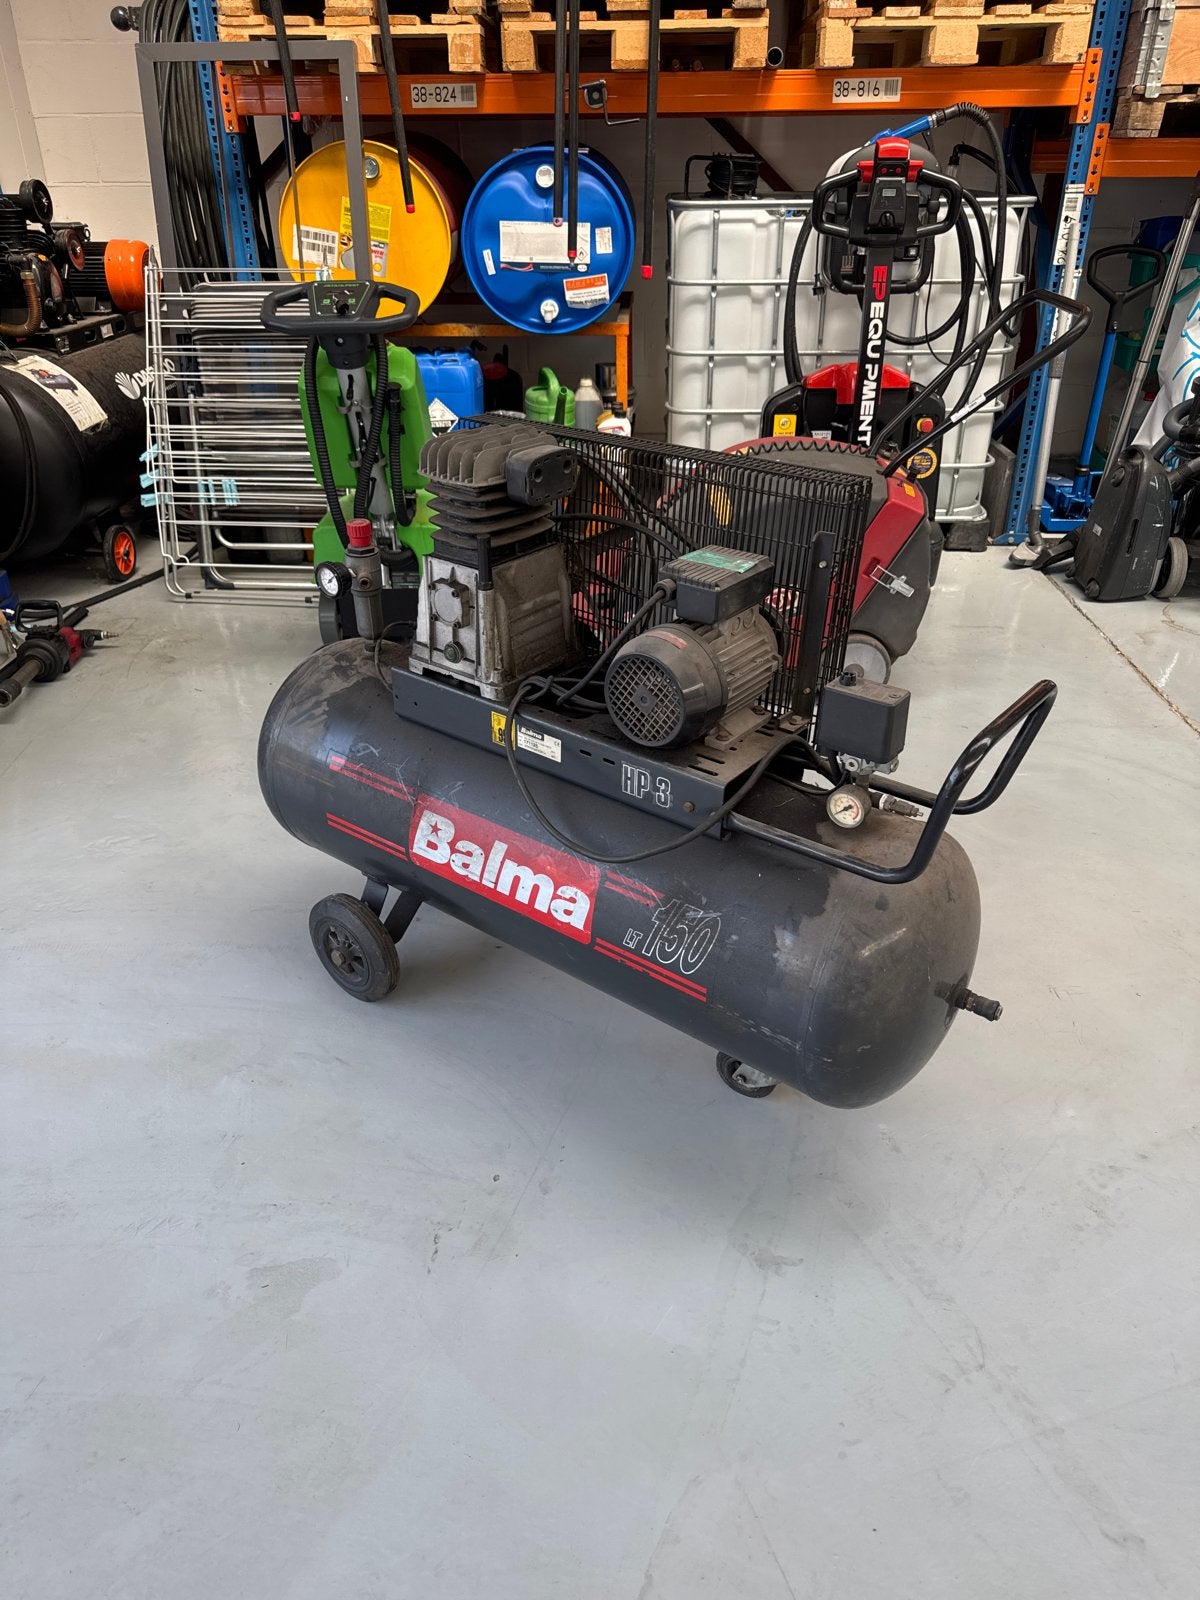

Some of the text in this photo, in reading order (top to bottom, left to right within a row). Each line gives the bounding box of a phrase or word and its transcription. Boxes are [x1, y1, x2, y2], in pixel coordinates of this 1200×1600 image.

[412, 86, 457, 103] 38-824
[834, 80, 880, 98] 38-816
[857, 265, 888, 447] EP EQUPMENT
[621, 763, 671, 809] HP 3
[412, 809, 591, 931] Balma
[622, 898, 721, 975] LT 150
